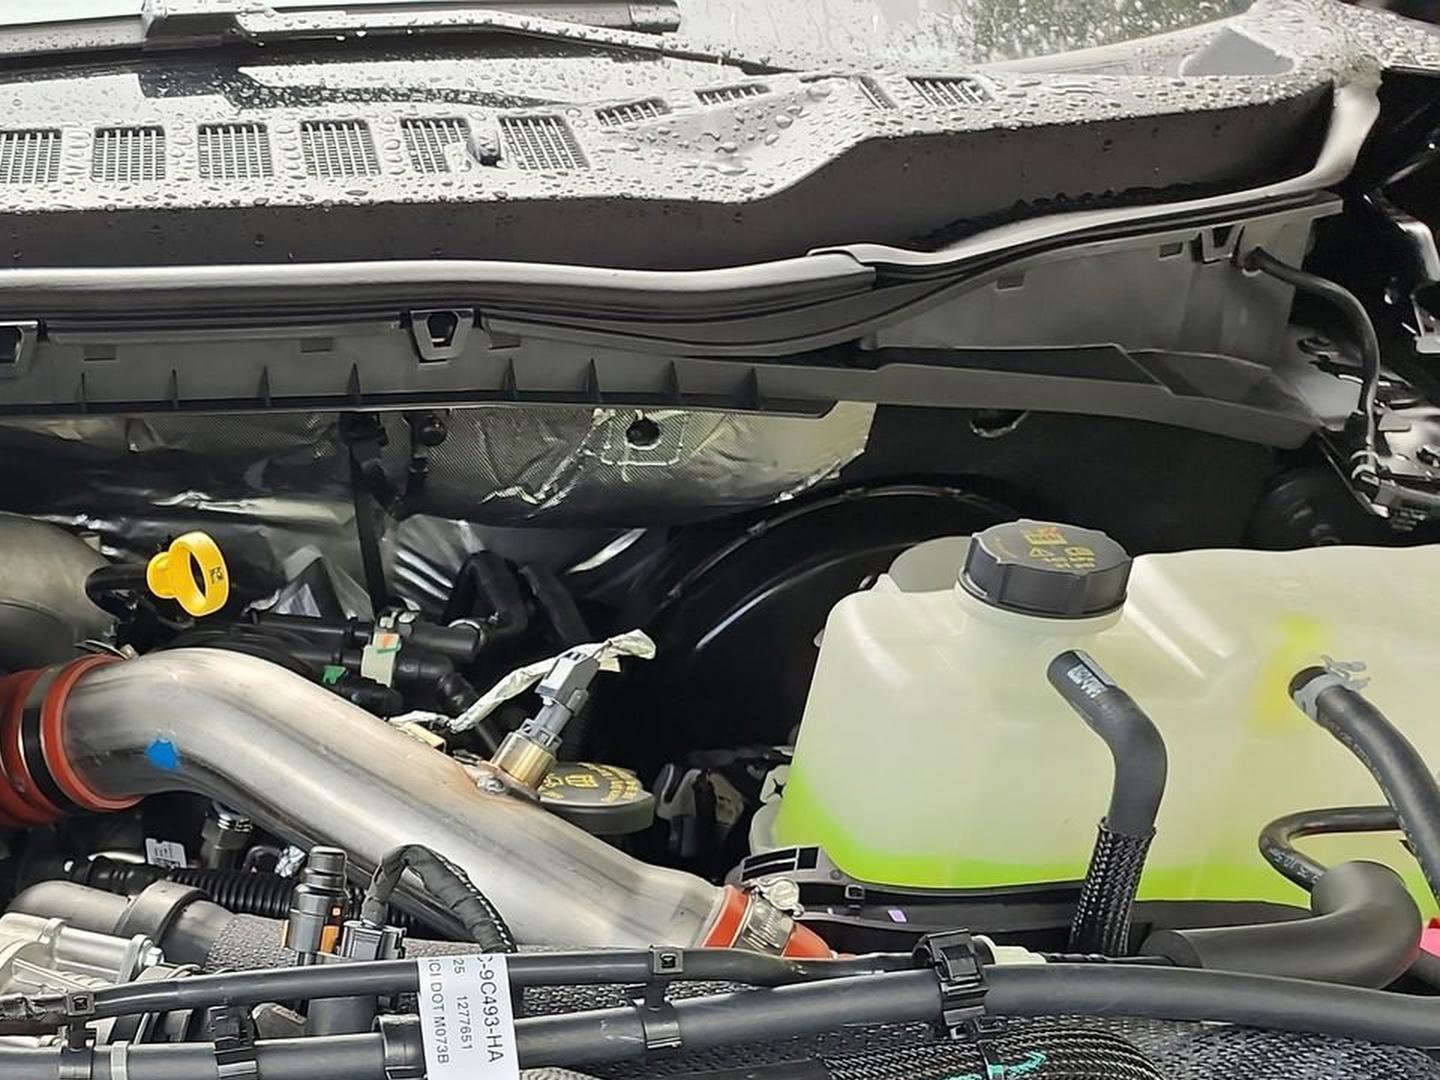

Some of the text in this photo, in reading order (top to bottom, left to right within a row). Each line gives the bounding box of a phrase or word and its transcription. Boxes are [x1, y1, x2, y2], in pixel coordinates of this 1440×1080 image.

[430, 982, 445, 1012] DOT
[433, 1016, 449, 1064] M073B
[457, 996, 472, 1050] 1277651
